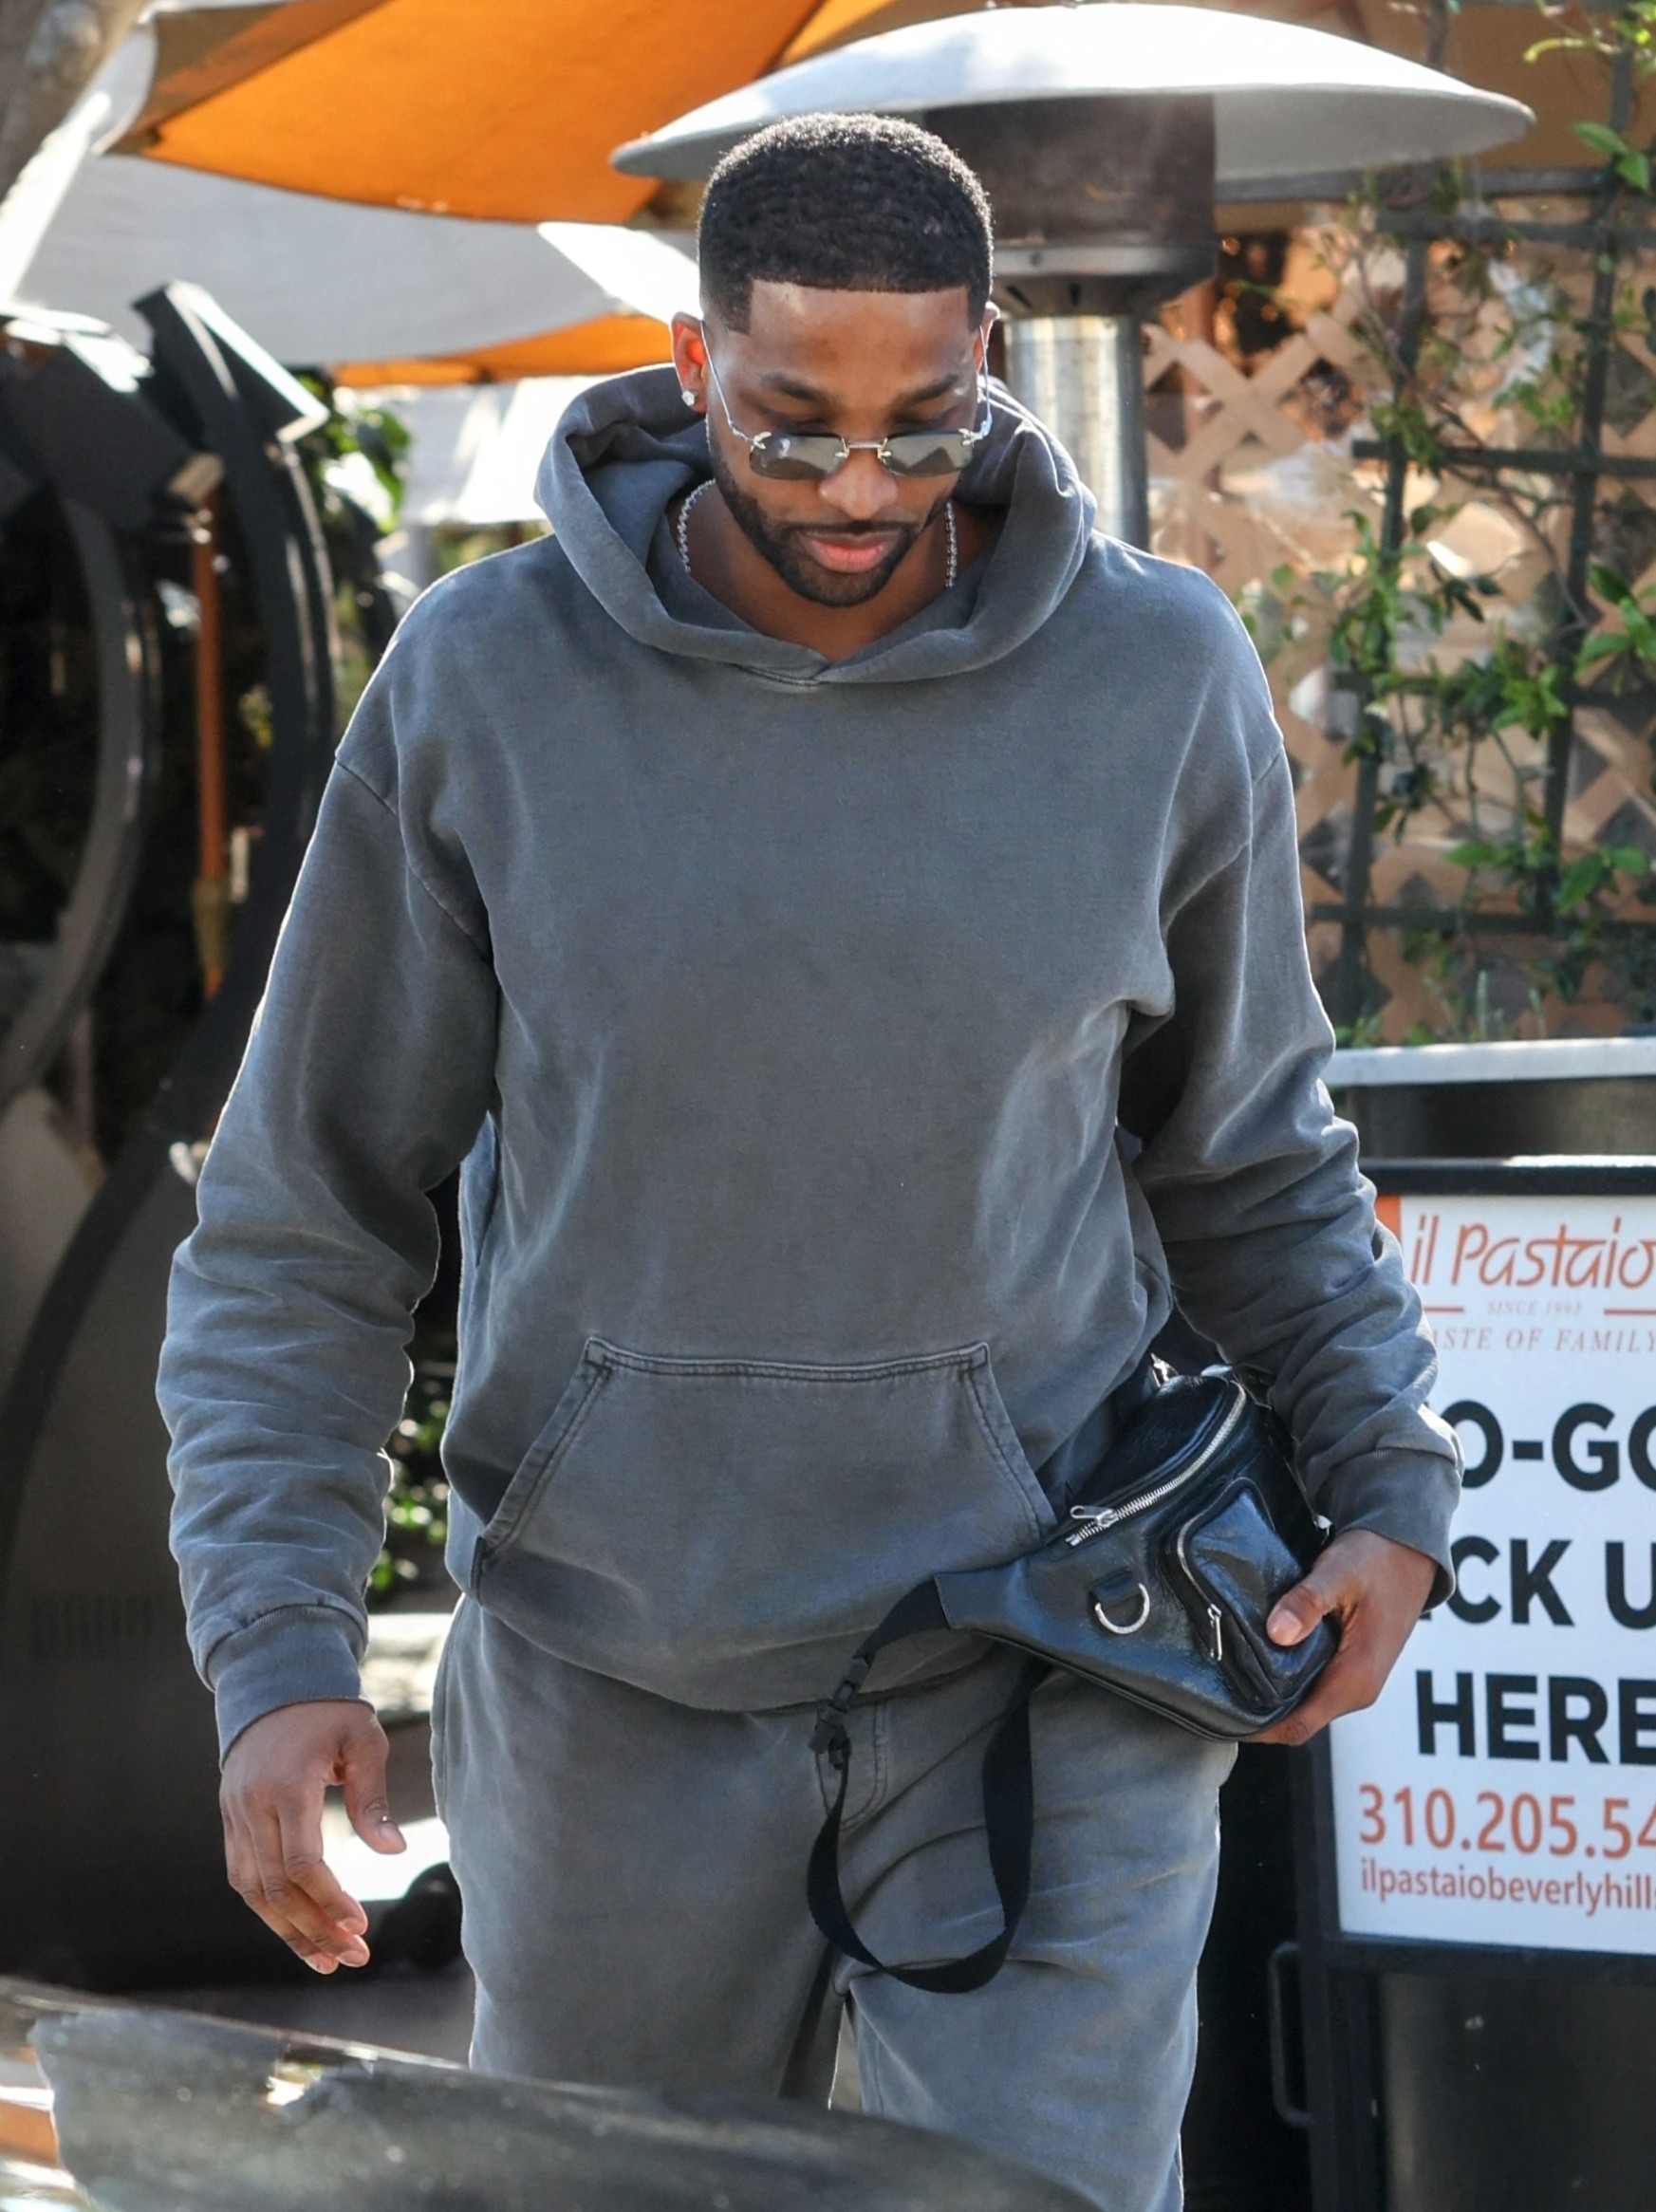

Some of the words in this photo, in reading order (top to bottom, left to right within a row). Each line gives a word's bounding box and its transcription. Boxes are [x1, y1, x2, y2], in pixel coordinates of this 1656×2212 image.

[1410, 1215, 1440, 1286] il
[1452, 1218, 1656, 1289] Pastaio
[1506, 1329, 1542, 1352] OF
[1419, 1535, 1575, 1627] CK
[1415, 1668, 1656, 1766] HERE
[1361, 1857, 1656, 1918] ilpastaiobeverlyhill
